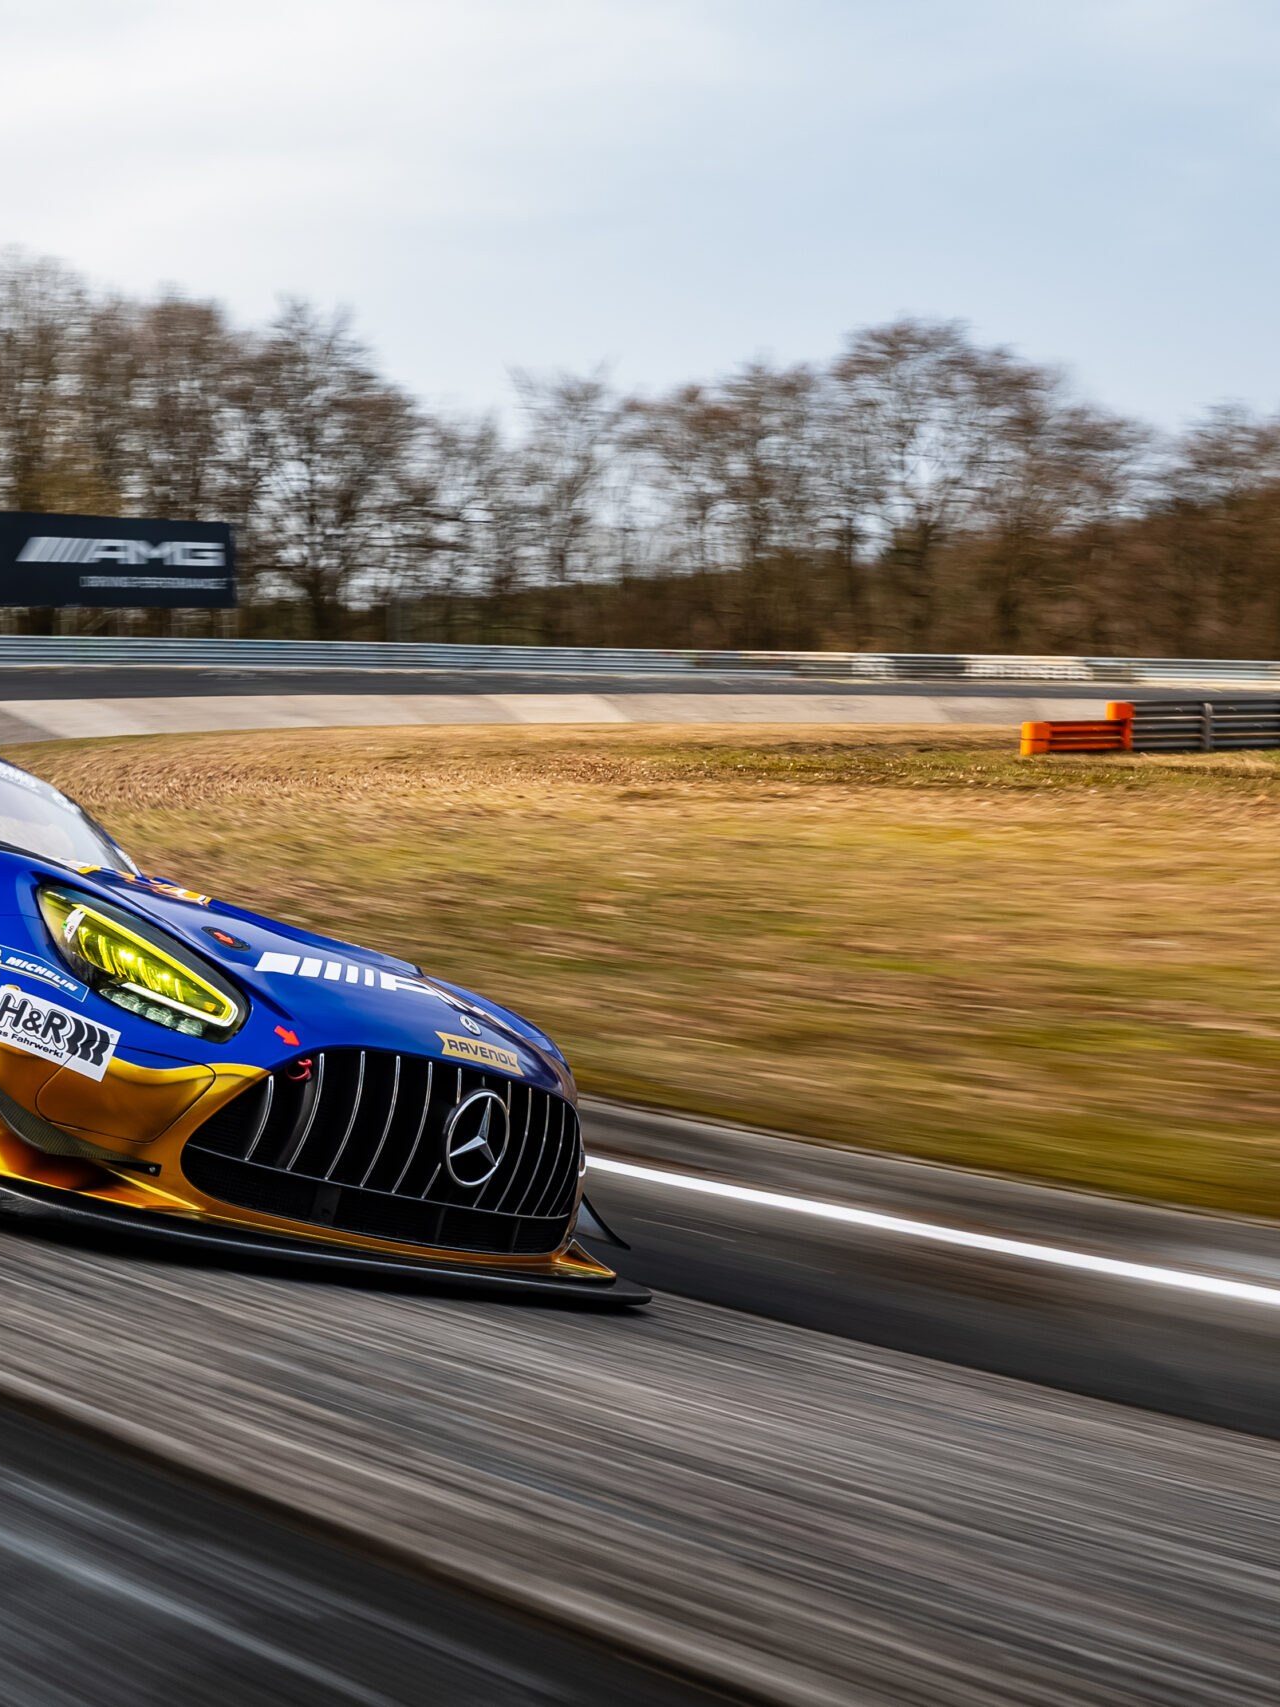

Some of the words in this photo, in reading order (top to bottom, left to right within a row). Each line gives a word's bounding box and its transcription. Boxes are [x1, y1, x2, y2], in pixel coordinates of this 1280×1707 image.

[86, 538, 225, 566] AMG
[5, 956, 78, 992] MICHELIN
[11, 1033, 64, 1059] Fahrwerk!
[447, 1038, 516, 1068] RAVENOL
